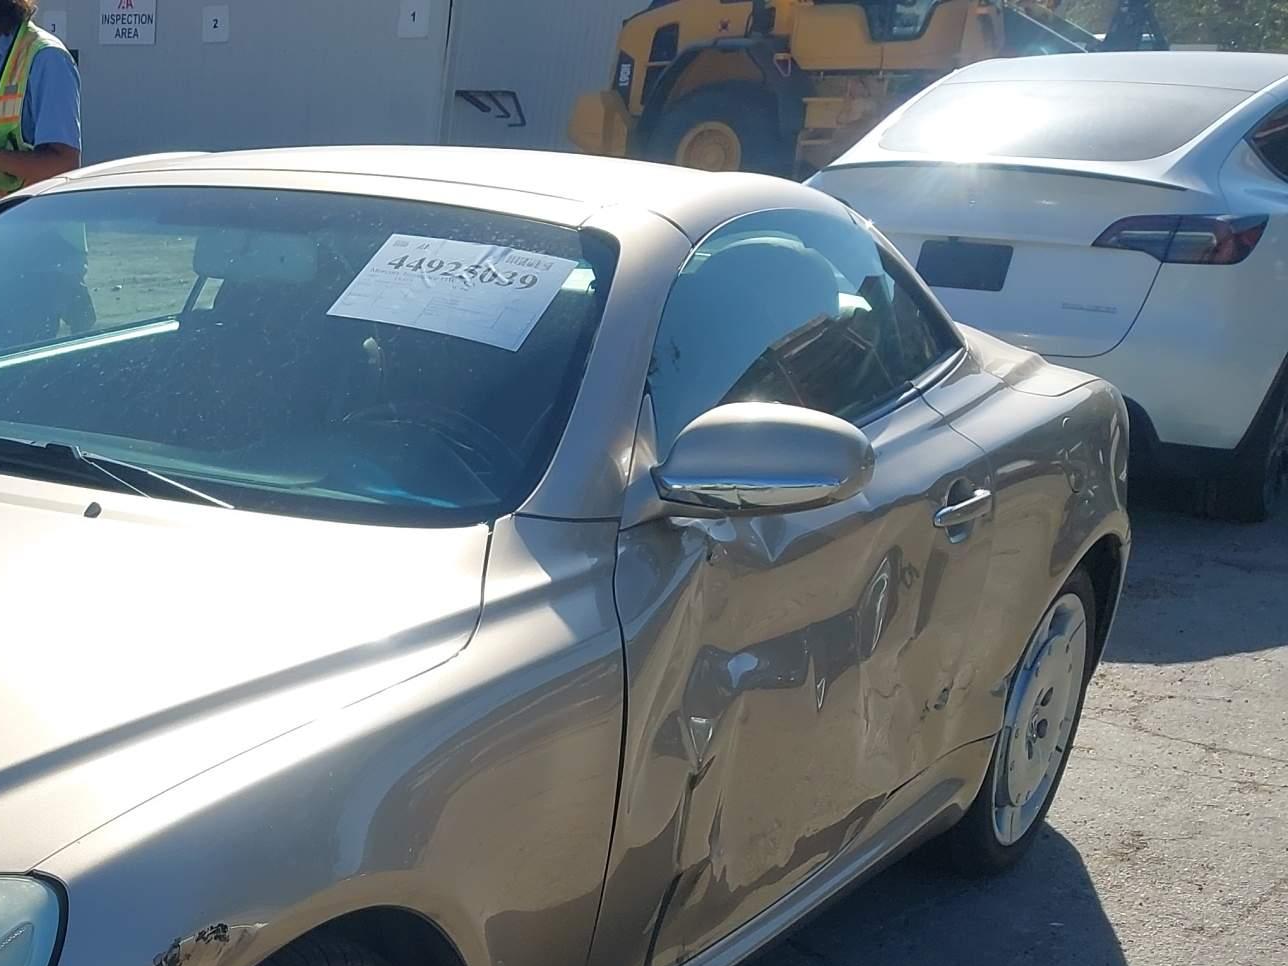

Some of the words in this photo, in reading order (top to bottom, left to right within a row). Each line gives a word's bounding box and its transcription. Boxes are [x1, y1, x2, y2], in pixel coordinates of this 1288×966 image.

[101, 13, 154, 25] INSPECTION
[212, 18, 219, 29] 2
[114, 27, 139, 39] AREA
[387, 254, 538, 290] 44925039
